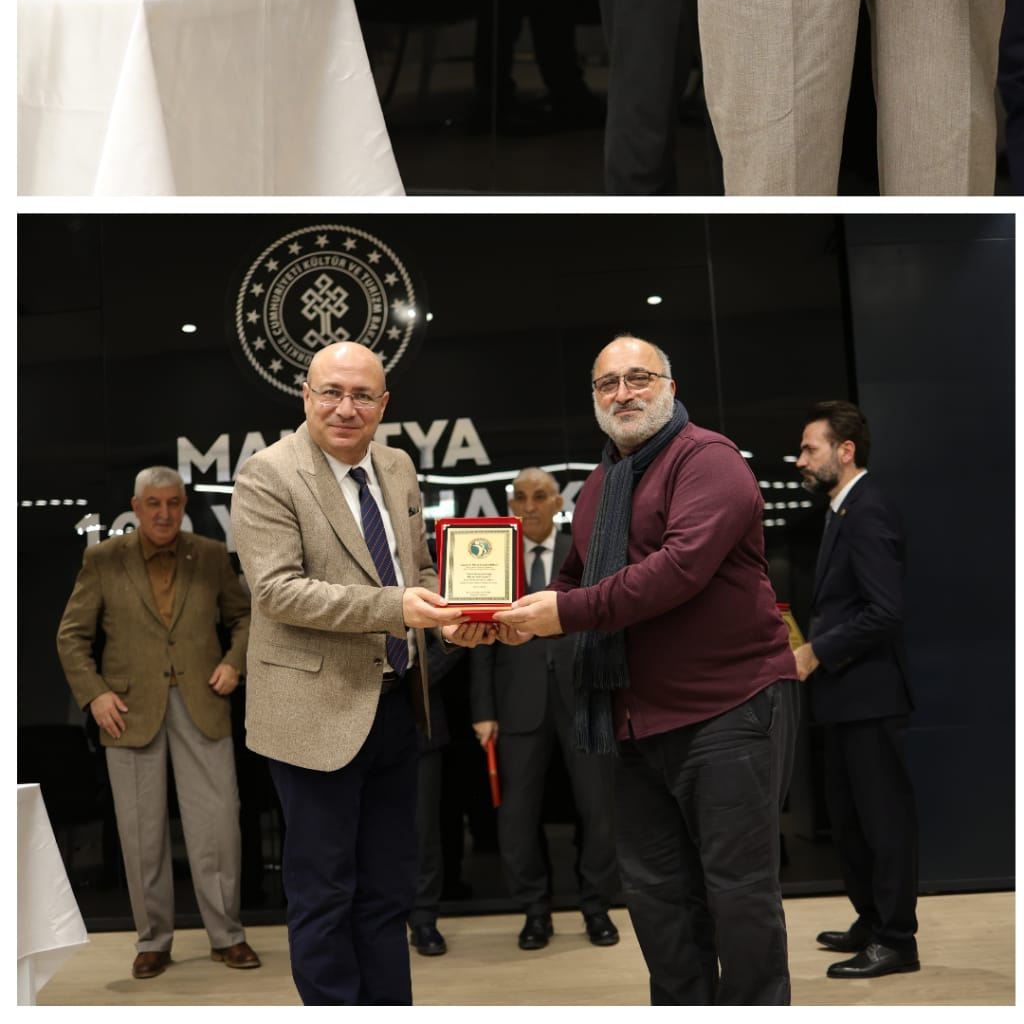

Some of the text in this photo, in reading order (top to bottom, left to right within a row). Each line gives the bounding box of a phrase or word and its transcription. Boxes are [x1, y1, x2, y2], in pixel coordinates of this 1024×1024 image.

[277, 337, 313, 364] ÜRKİYE
[302, 255, 346, 270] KÜLTÜR
[348, 262, 363, 275] VE
